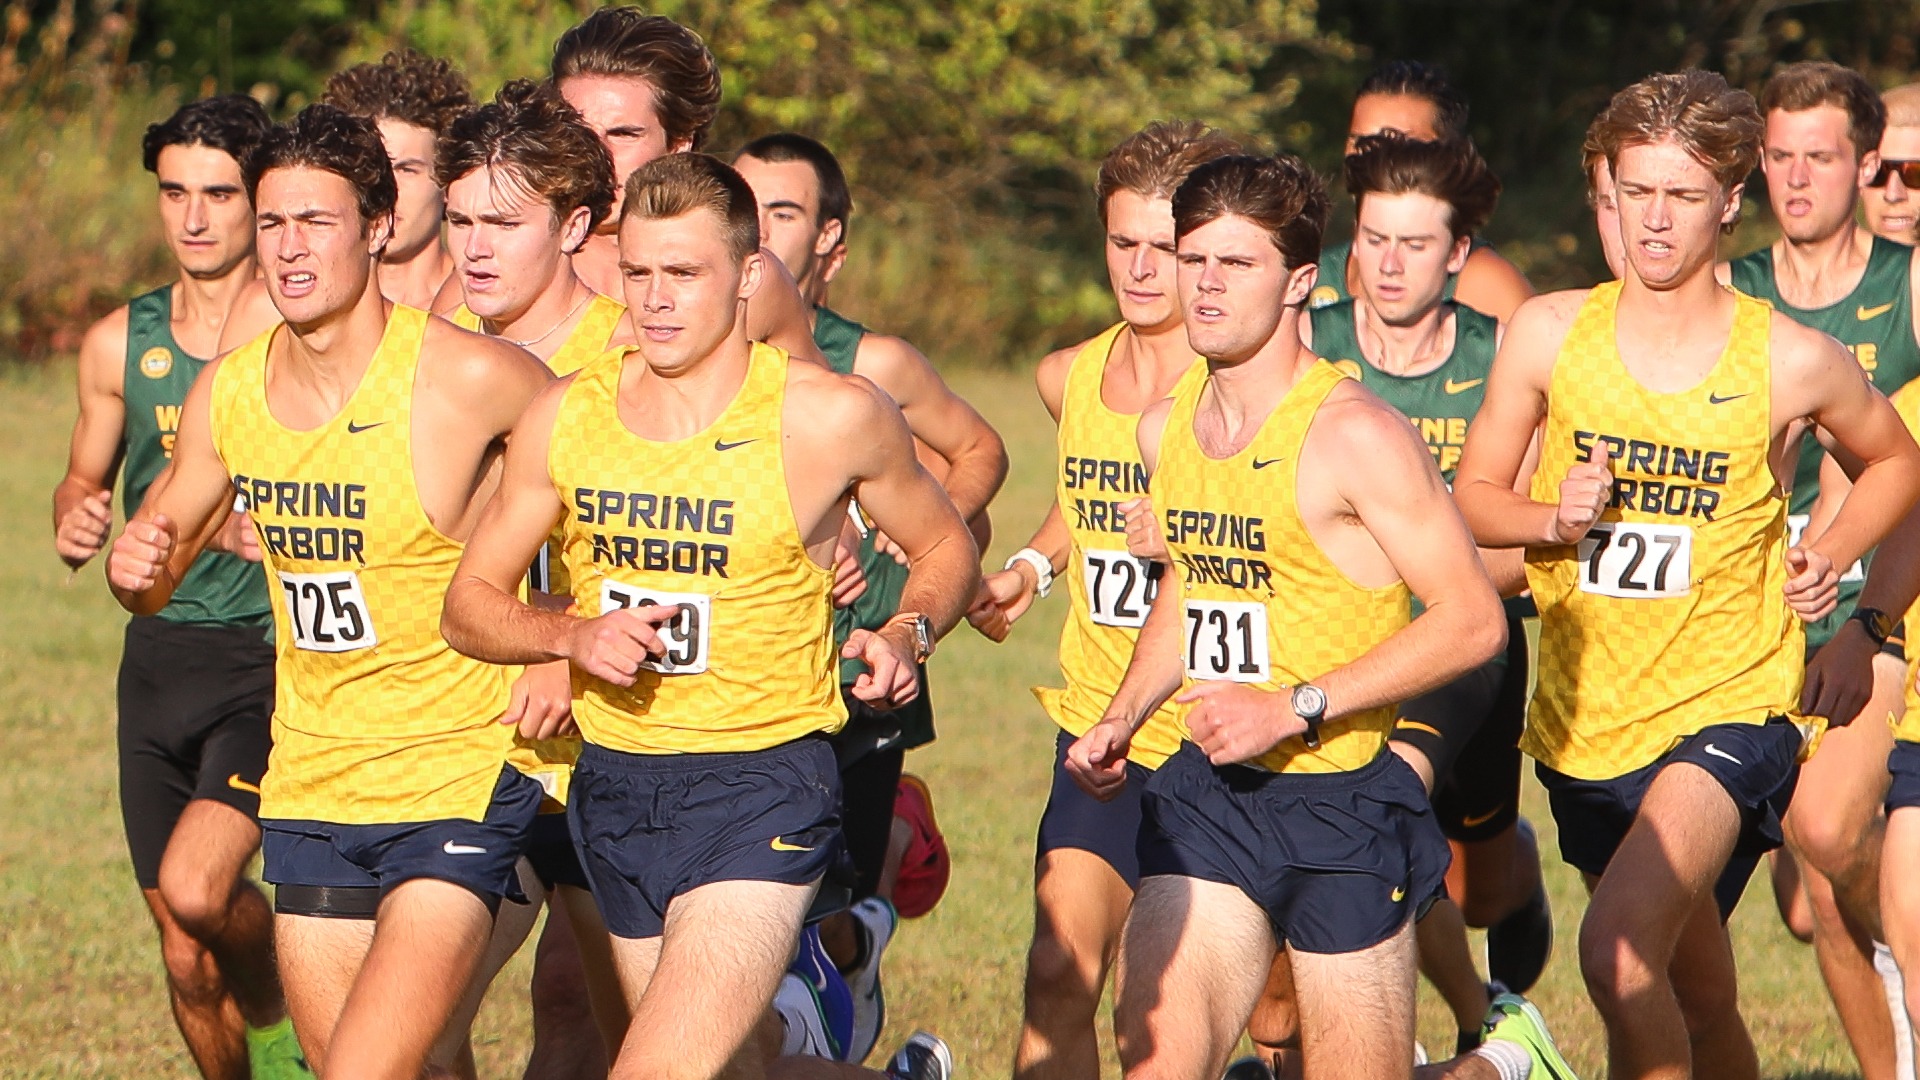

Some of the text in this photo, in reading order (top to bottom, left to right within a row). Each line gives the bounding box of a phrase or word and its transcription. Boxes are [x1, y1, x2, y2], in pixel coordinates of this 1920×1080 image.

[1410, 417, 1467, 444] NE
[1573, 430, 1731, 485] SPRING
[233, 473, 366, 519] SPRING
[575, 487, 735, 536] SPRING
[1611, 477, 1720, 522] RBOR
[1166, 509, 1267, 552] SPRING
[593, 533, 729, 578] ARBOR
[1180, 552, 1275, 591] ARBOR
[1585, 528, 1681, 591] 727
[282, 579, 365, 643] 725
[1187, 608, 1260, 674] 731
